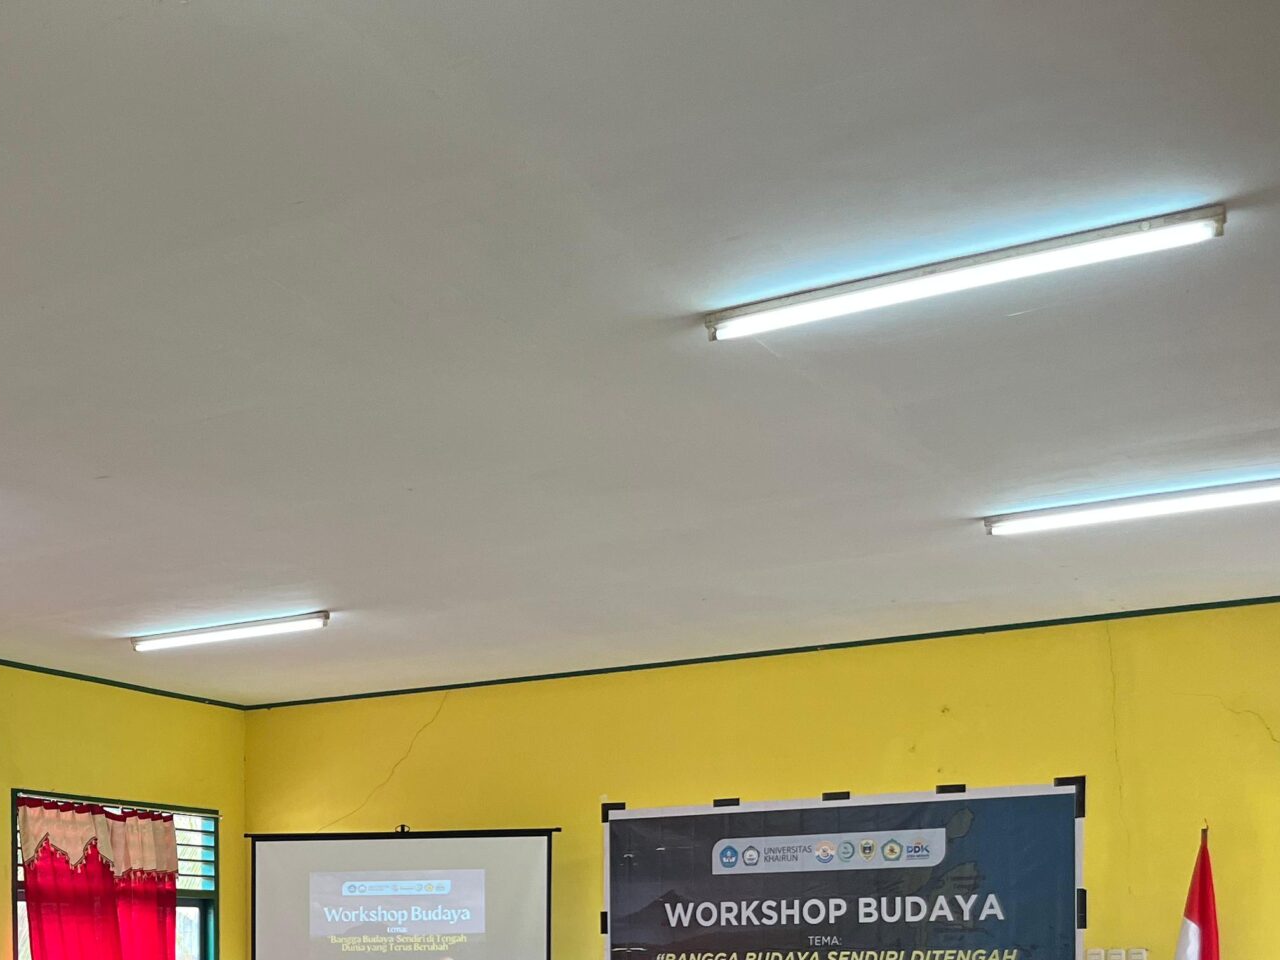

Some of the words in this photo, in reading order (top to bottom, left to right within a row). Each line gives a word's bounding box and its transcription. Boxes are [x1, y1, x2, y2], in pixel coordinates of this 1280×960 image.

[763, 845, 813, 855] UNIVERSITAS
[763, 854, 799, 863] KHAIRUN
[323, 905, 408, 924] Workshop
[411, 905, 470, 924] Budaya
[664, 898, 847, 928] WORKSHOP
[858, 893, 1005, 923] BUDAYA
[807, 936, 842, 946] TEMA:
